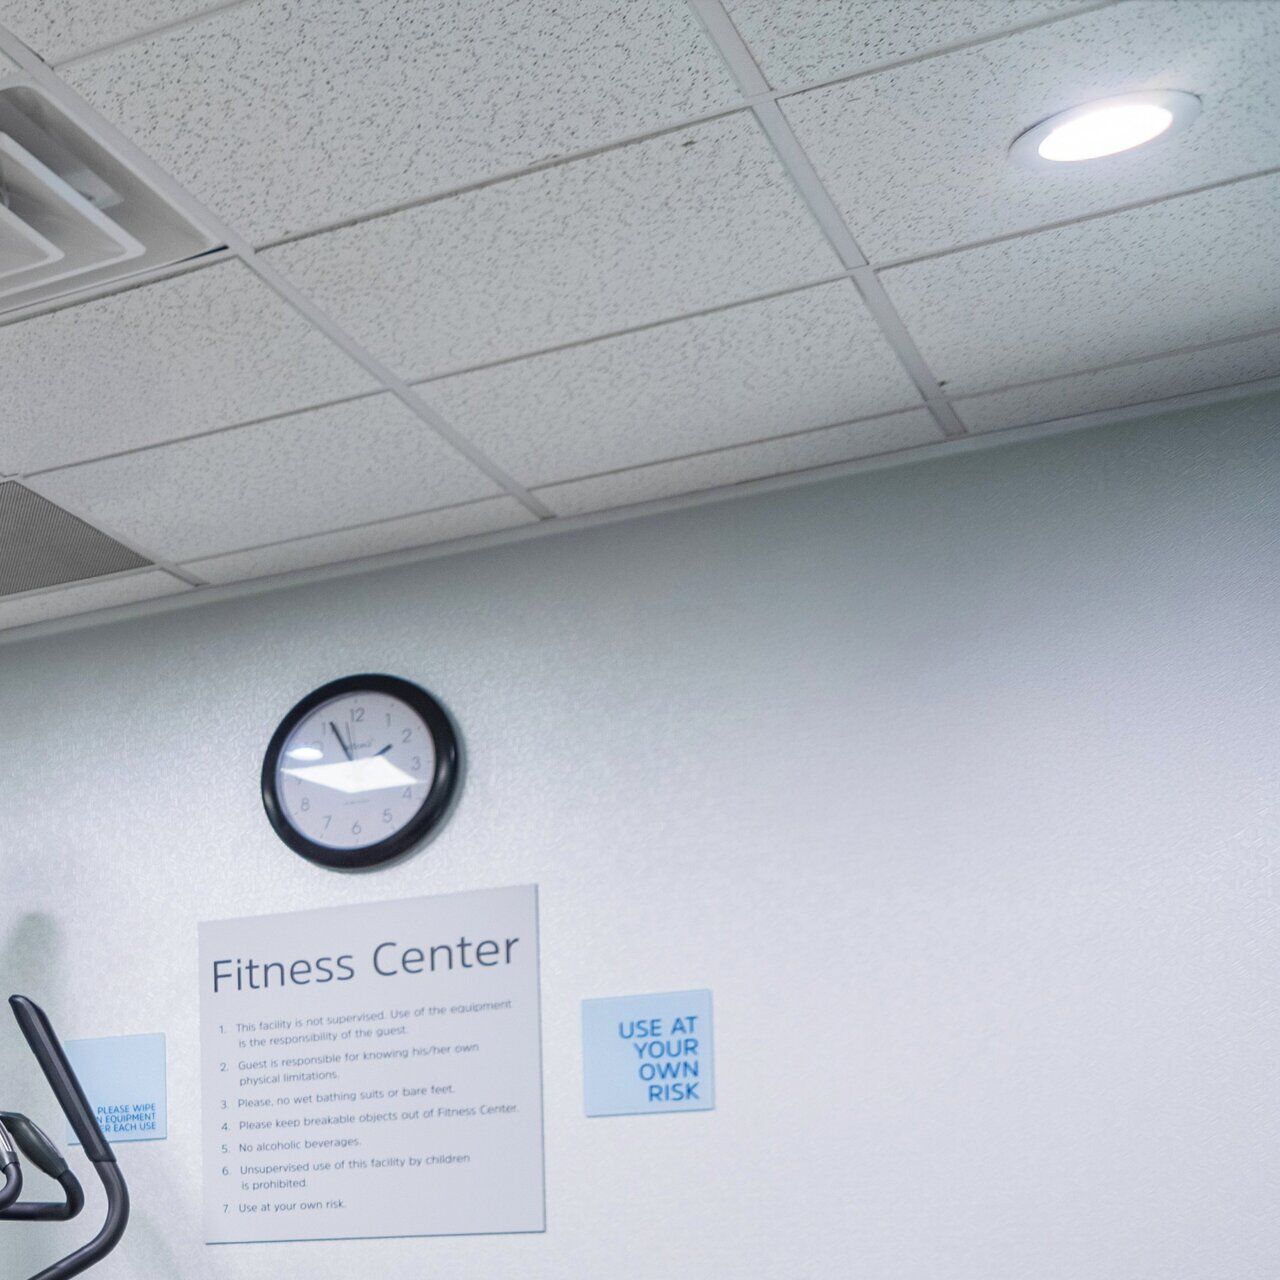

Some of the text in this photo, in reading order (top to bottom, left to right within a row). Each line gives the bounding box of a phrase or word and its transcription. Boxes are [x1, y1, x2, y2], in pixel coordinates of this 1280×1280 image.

[350, 707, 366, 722] 12
[385, 713, 391, 727] 1
[402, 728, 413, 743] 2
[412, 756, 421, 771] 3
[402, 787, 412, 799] 4
[300, 797, 310, 811] 8
[322, 816, 332, 830] 7
[382, 808, 393, 823] 5
[352, 820, 362, 835] 6
[213, 937, 519, 993] Fitness Center
[236, 1023, 256, 1033] This
[259, 1020, 291, 1032] facility
[295, 1019, 303, 1027] is
[306, 1017, 323, 1026] not
[391, 1010, 410, 1019] Use
[414, 1006, 426, 1017] of
[429, 1006, 447, 1016] the
[450, 1000, 512, 1014] equipment
[619, 1016, 698, 1039] USE AT
[239, 1040, 246, 1048] is
[250, 1038, 266, 1047] the
[270, 1032, 338, 1046] responsibility
[341, 1030, 351, 1040] of
[356, 1028, 372, 1038] the
[634, 1038, 699, 1059] YOUR
[220, 1044, 479, 1072] 2. Guest is responsible for knowing his/her own
[639, 1060, 699, 1081] OWN
[240, 1074, 280, 1086] physical
[238, 1098, 273, 1108] Please,
[276, 1096, 290, 1105] no
[294, 1095, 312, 1104] wet
[316, 1091, 357, 1104] bathing
[360, 1090, 384, 1099] suits
[402, 1086, 427, 1096] bare
[431, 1084, 455, 1094] feet.
[648, 1082, 700, 1101] RISK
[98, 1103, 156, 1114] PLEASE WIPE
[106, 1113, 156, 1124] EQUIPMENT
[240, 1120, 273, 1130] Please
[276, 1118, 301, 1128] keep
[304, 1114, 355, 1126] breakable
[358, 1110, 398, 1123] objects
[402, 1110, 420, 1120] out
[424, 1108, 435, 1118] of
[438, 1107, 477, 1117] Fitness
[479, 1104, 519, 1115] Center.
[114, 1124, 136, 1132] EACH
[140, 1122, 156, 1130] USE
[239, 1144, 253, 1152] No
[256, 1140, 301, 1152] alcoholic
[304, 1137, 362, 1149] beverages.
[240, 1163, 310, 1175] Unsupervised
[313, 1162, 331, 1171] use
[334, 1159, 345, 1169] of
[348, 1159, 368, 1169] this
[370, 1157, 406, 1169] facility
[409, 1156, 422, 1167] by
[426, 1154, 471, 1165] children
[242, 1182, 249, 1190] is
[239, 1203, 258, 1213] Use
[261, 1203, 270, 1212] at
[274, 1202, 297, 1212] your
[300, 1200, 323, 1210] own
[326, 1200, 347, 1209] risk.
